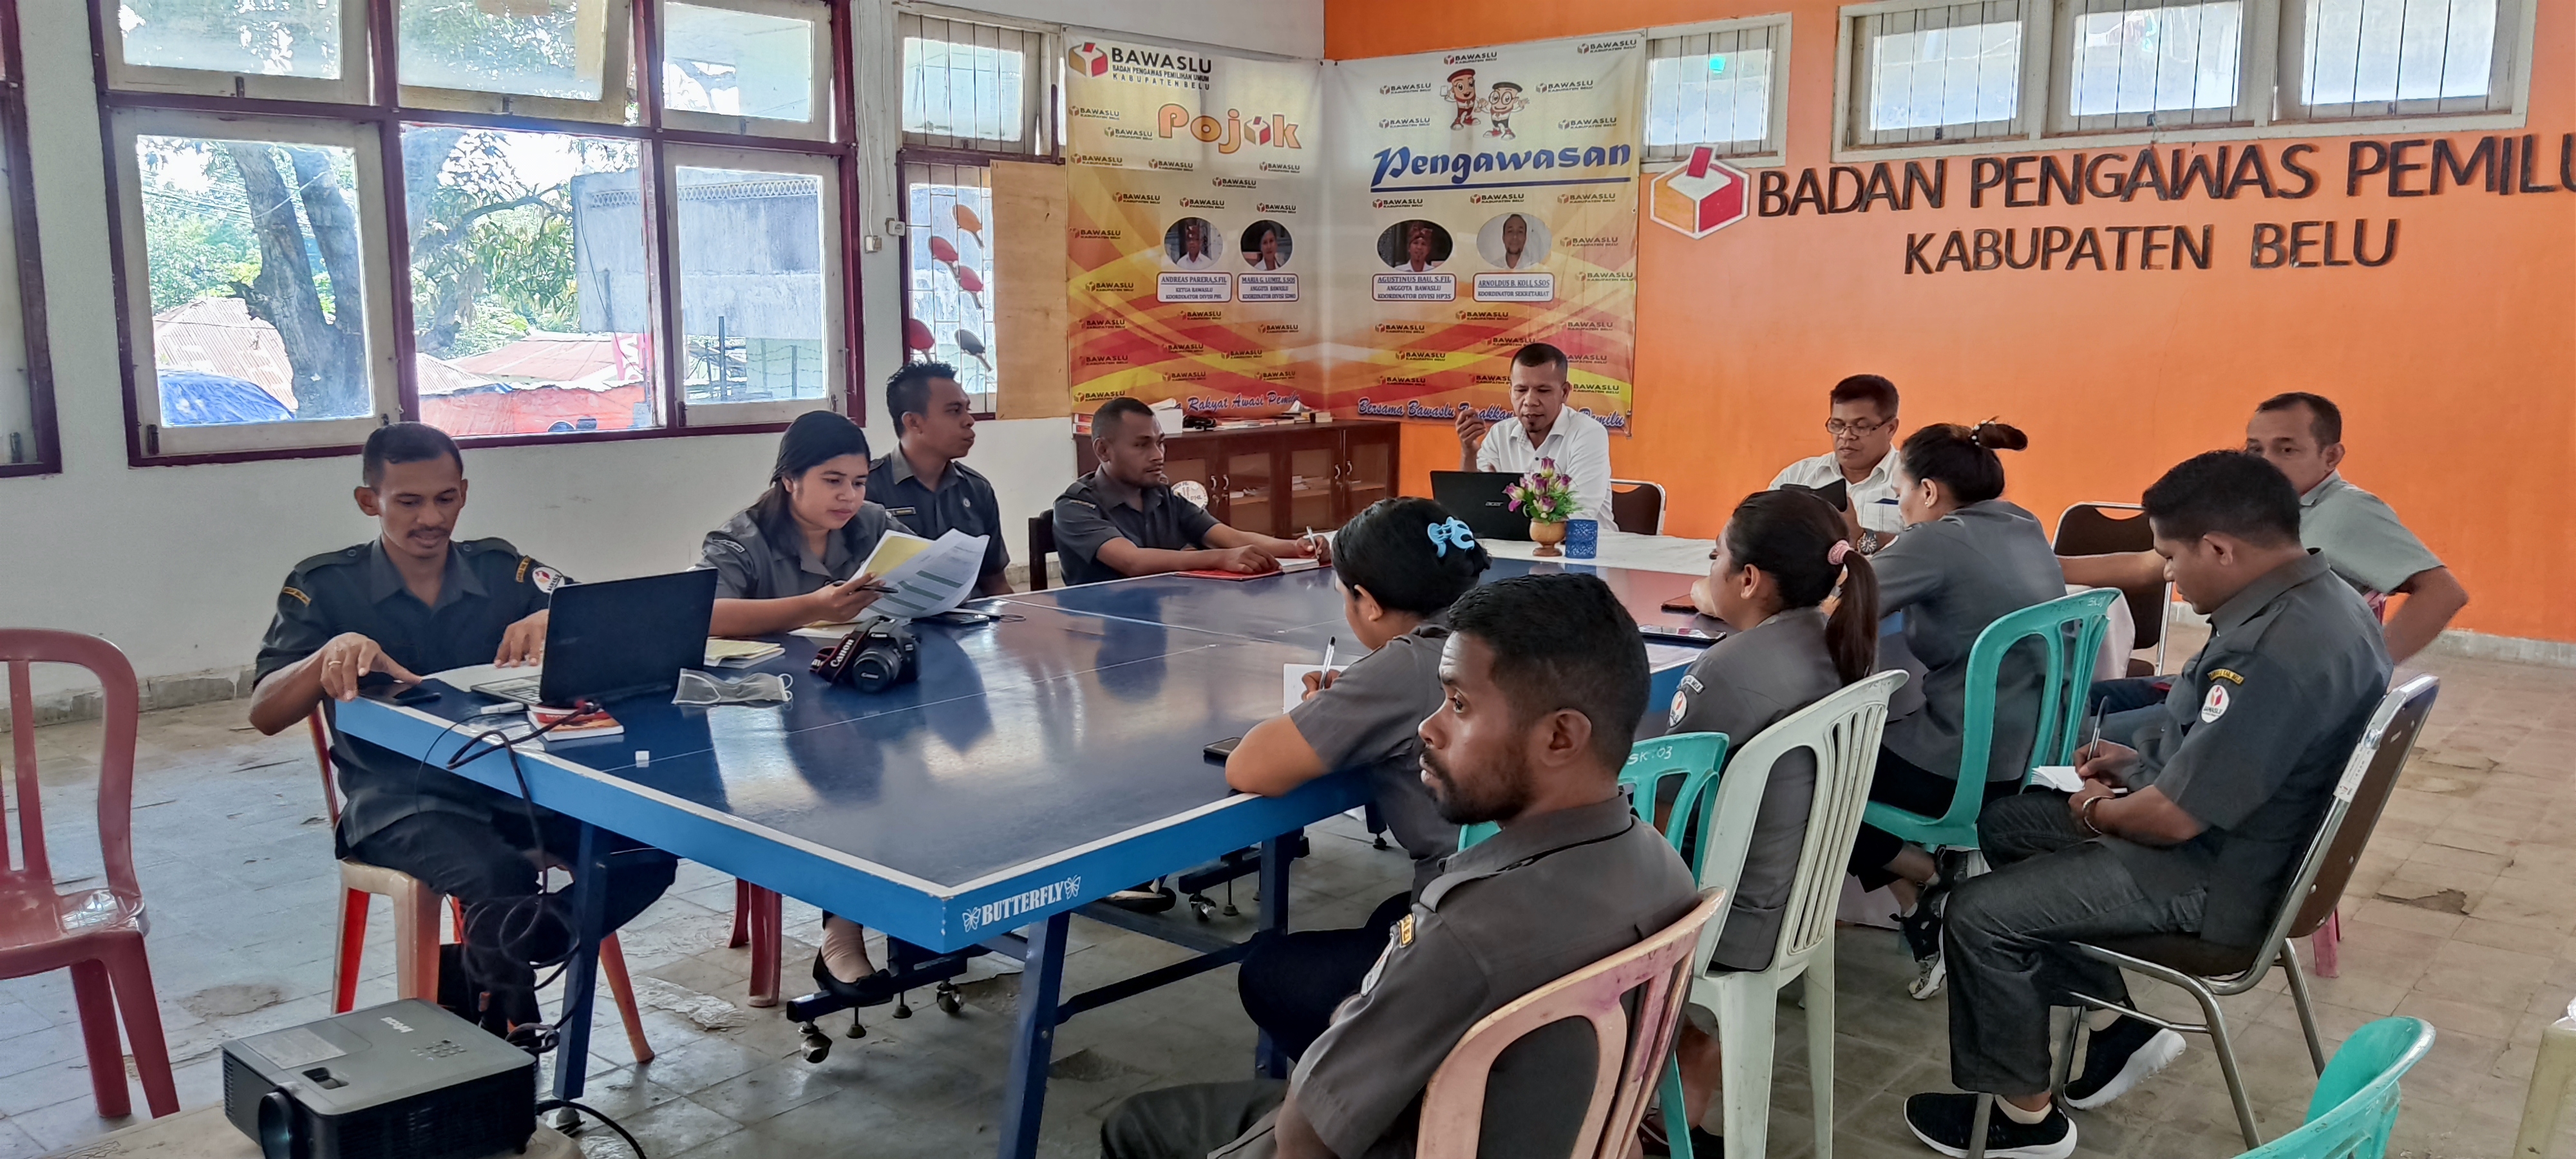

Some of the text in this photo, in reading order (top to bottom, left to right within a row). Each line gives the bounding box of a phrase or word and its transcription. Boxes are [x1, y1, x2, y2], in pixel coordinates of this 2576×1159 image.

[1590, 39, 1636, 49] BAWASLU
[1111, 47, 1211, 74] BAWASLU
[1455, 52, 1497, 61] BAWASLU
[1112, 64, 1209, 82] BADAN PENGAWAS PEMILIHAN UMUM
[1113, 73, 1210, 90] KABUPATEN BELU
[1548, 80, 1593, 89] BAWASLU
[1080, 108, 1120, 117] BAWASLU
[1571, 117, 1616, 126] BAWASLU
[1115, 129, 1153, 137] BAWASLU
[1370, 144, 1631, 187] Pengawasan
[1759, 159, 1947, 217] BADAN
[1970, 143, 2319, 209] PENGAWAS
[1904, 218, 2401, 274] KABUPATEN BELU
[1187, 395, 1228, 412] Rakyat
[1231, 393, 1264, 408] Awasi
[1359, 397, 1404, 415] Bersama
[1408, 400, 1455, 418] Bawaslu
[830, 639, 855, 667] Canon
[981, 880, 1065, 926] BUTTERFLY
